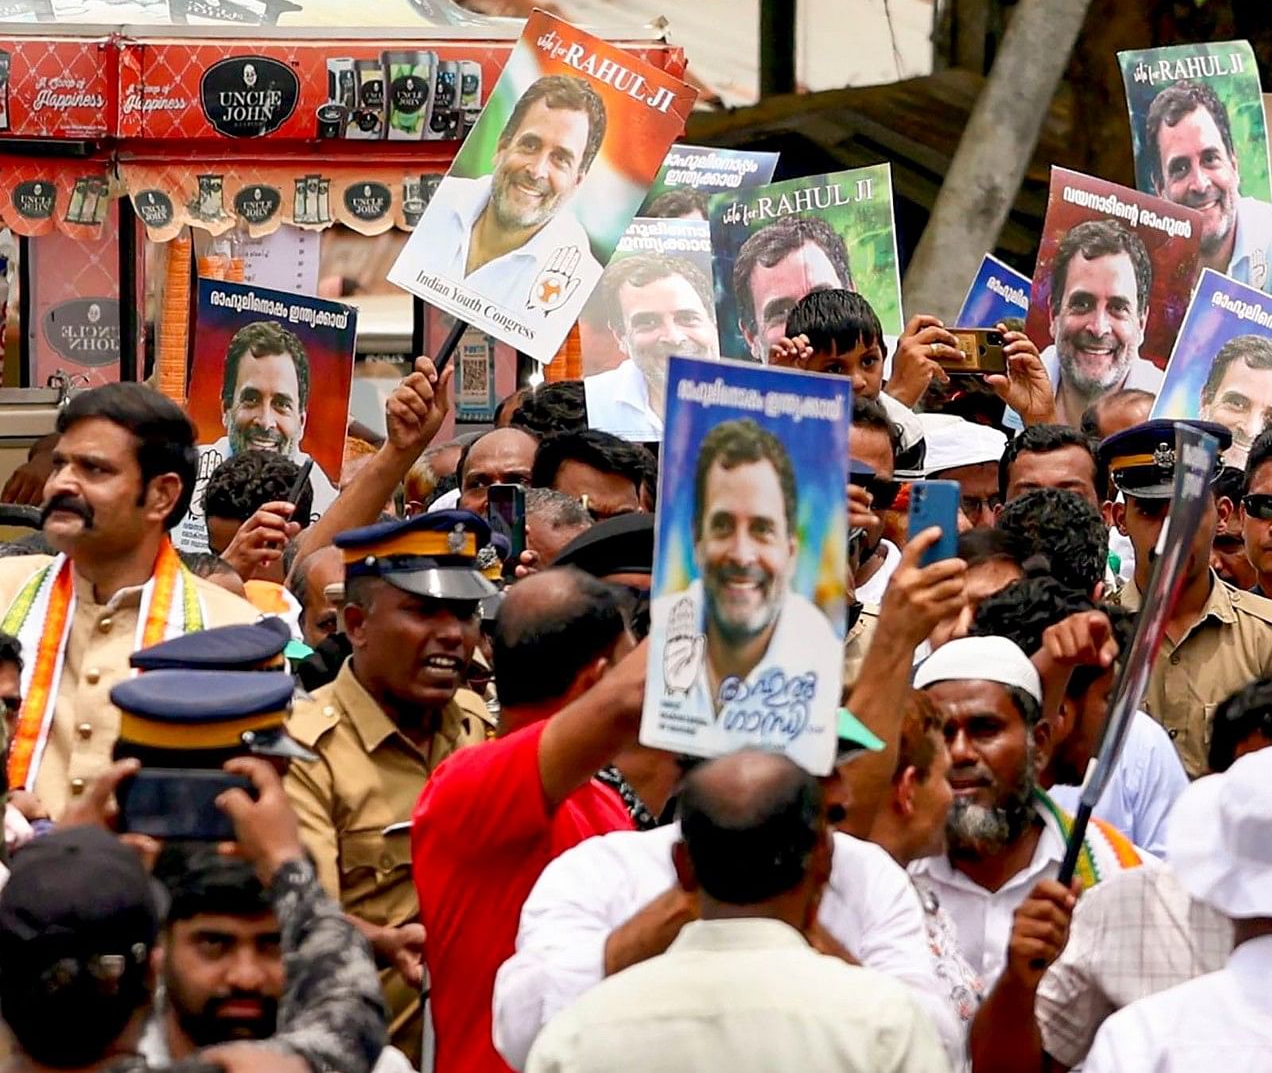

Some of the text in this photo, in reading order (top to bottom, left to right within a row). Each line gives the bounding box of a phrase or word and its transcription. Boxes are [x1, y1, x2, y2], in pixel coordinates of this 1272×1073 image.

[563, 42, 647, 101] RAHUL
[647, 87, 676, 113] JI
[1158, 56, 1229, 81] RAHUL
[1229, 53, 1244, 74] JI
[33, 90, 104, 111] Happiness
[219, 90, 282, 108] UNCLE
[222, 106, 276, 122] JOHN
[758, 184, 849, 219] RAHUL
[854, 179, 873, 202] JI
[416, 269, 536, 340] Indian Youth Congress
